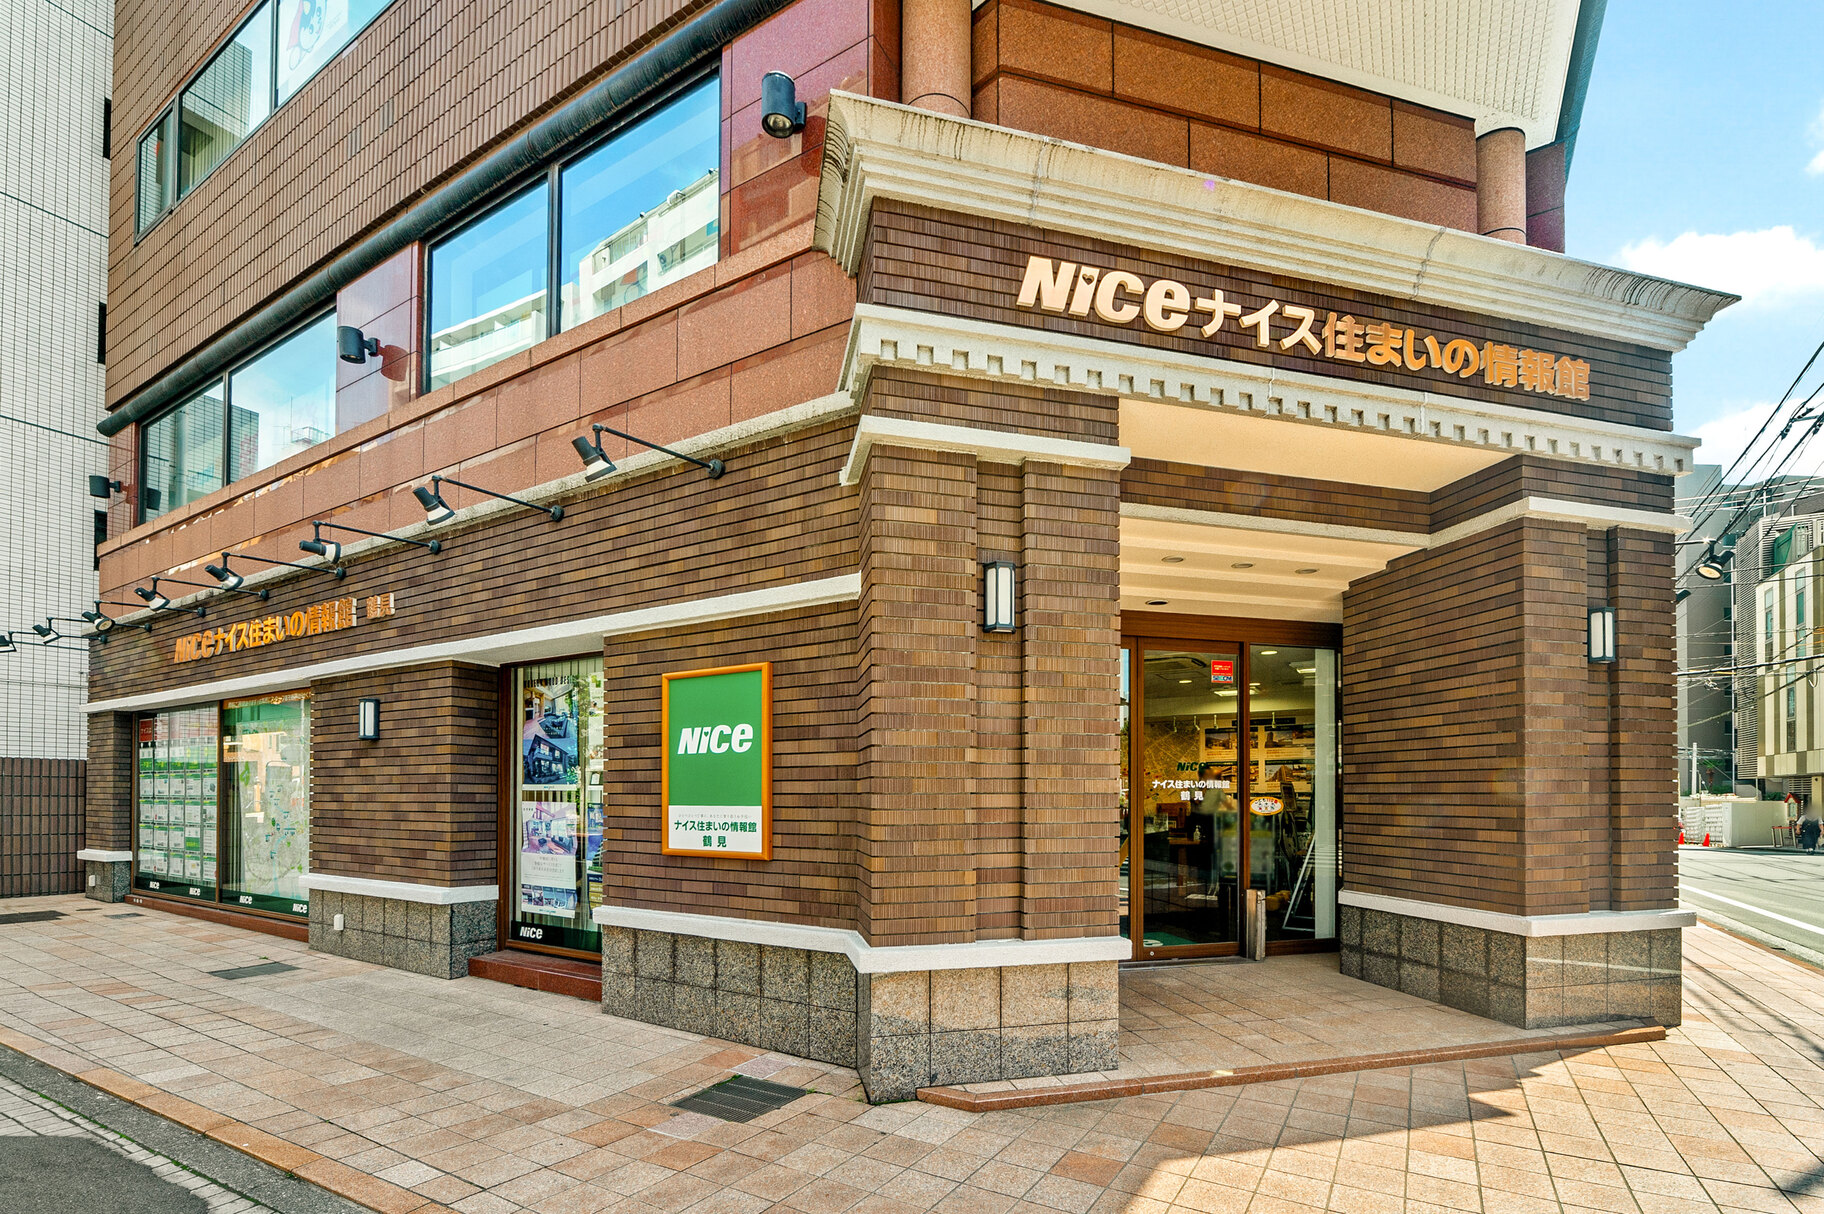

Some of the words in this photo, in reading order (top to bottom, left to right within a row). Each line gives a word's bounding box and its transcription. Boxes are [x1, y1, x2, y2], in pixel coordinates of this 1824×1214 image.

[677, 723, 754, 755] Nice
[1152, 780, 1230, 789] ナイス住まいの情報館
[674, 820, 757, 833] ナイス住まいの情報館
[519, 926, 543, 939] Nice
